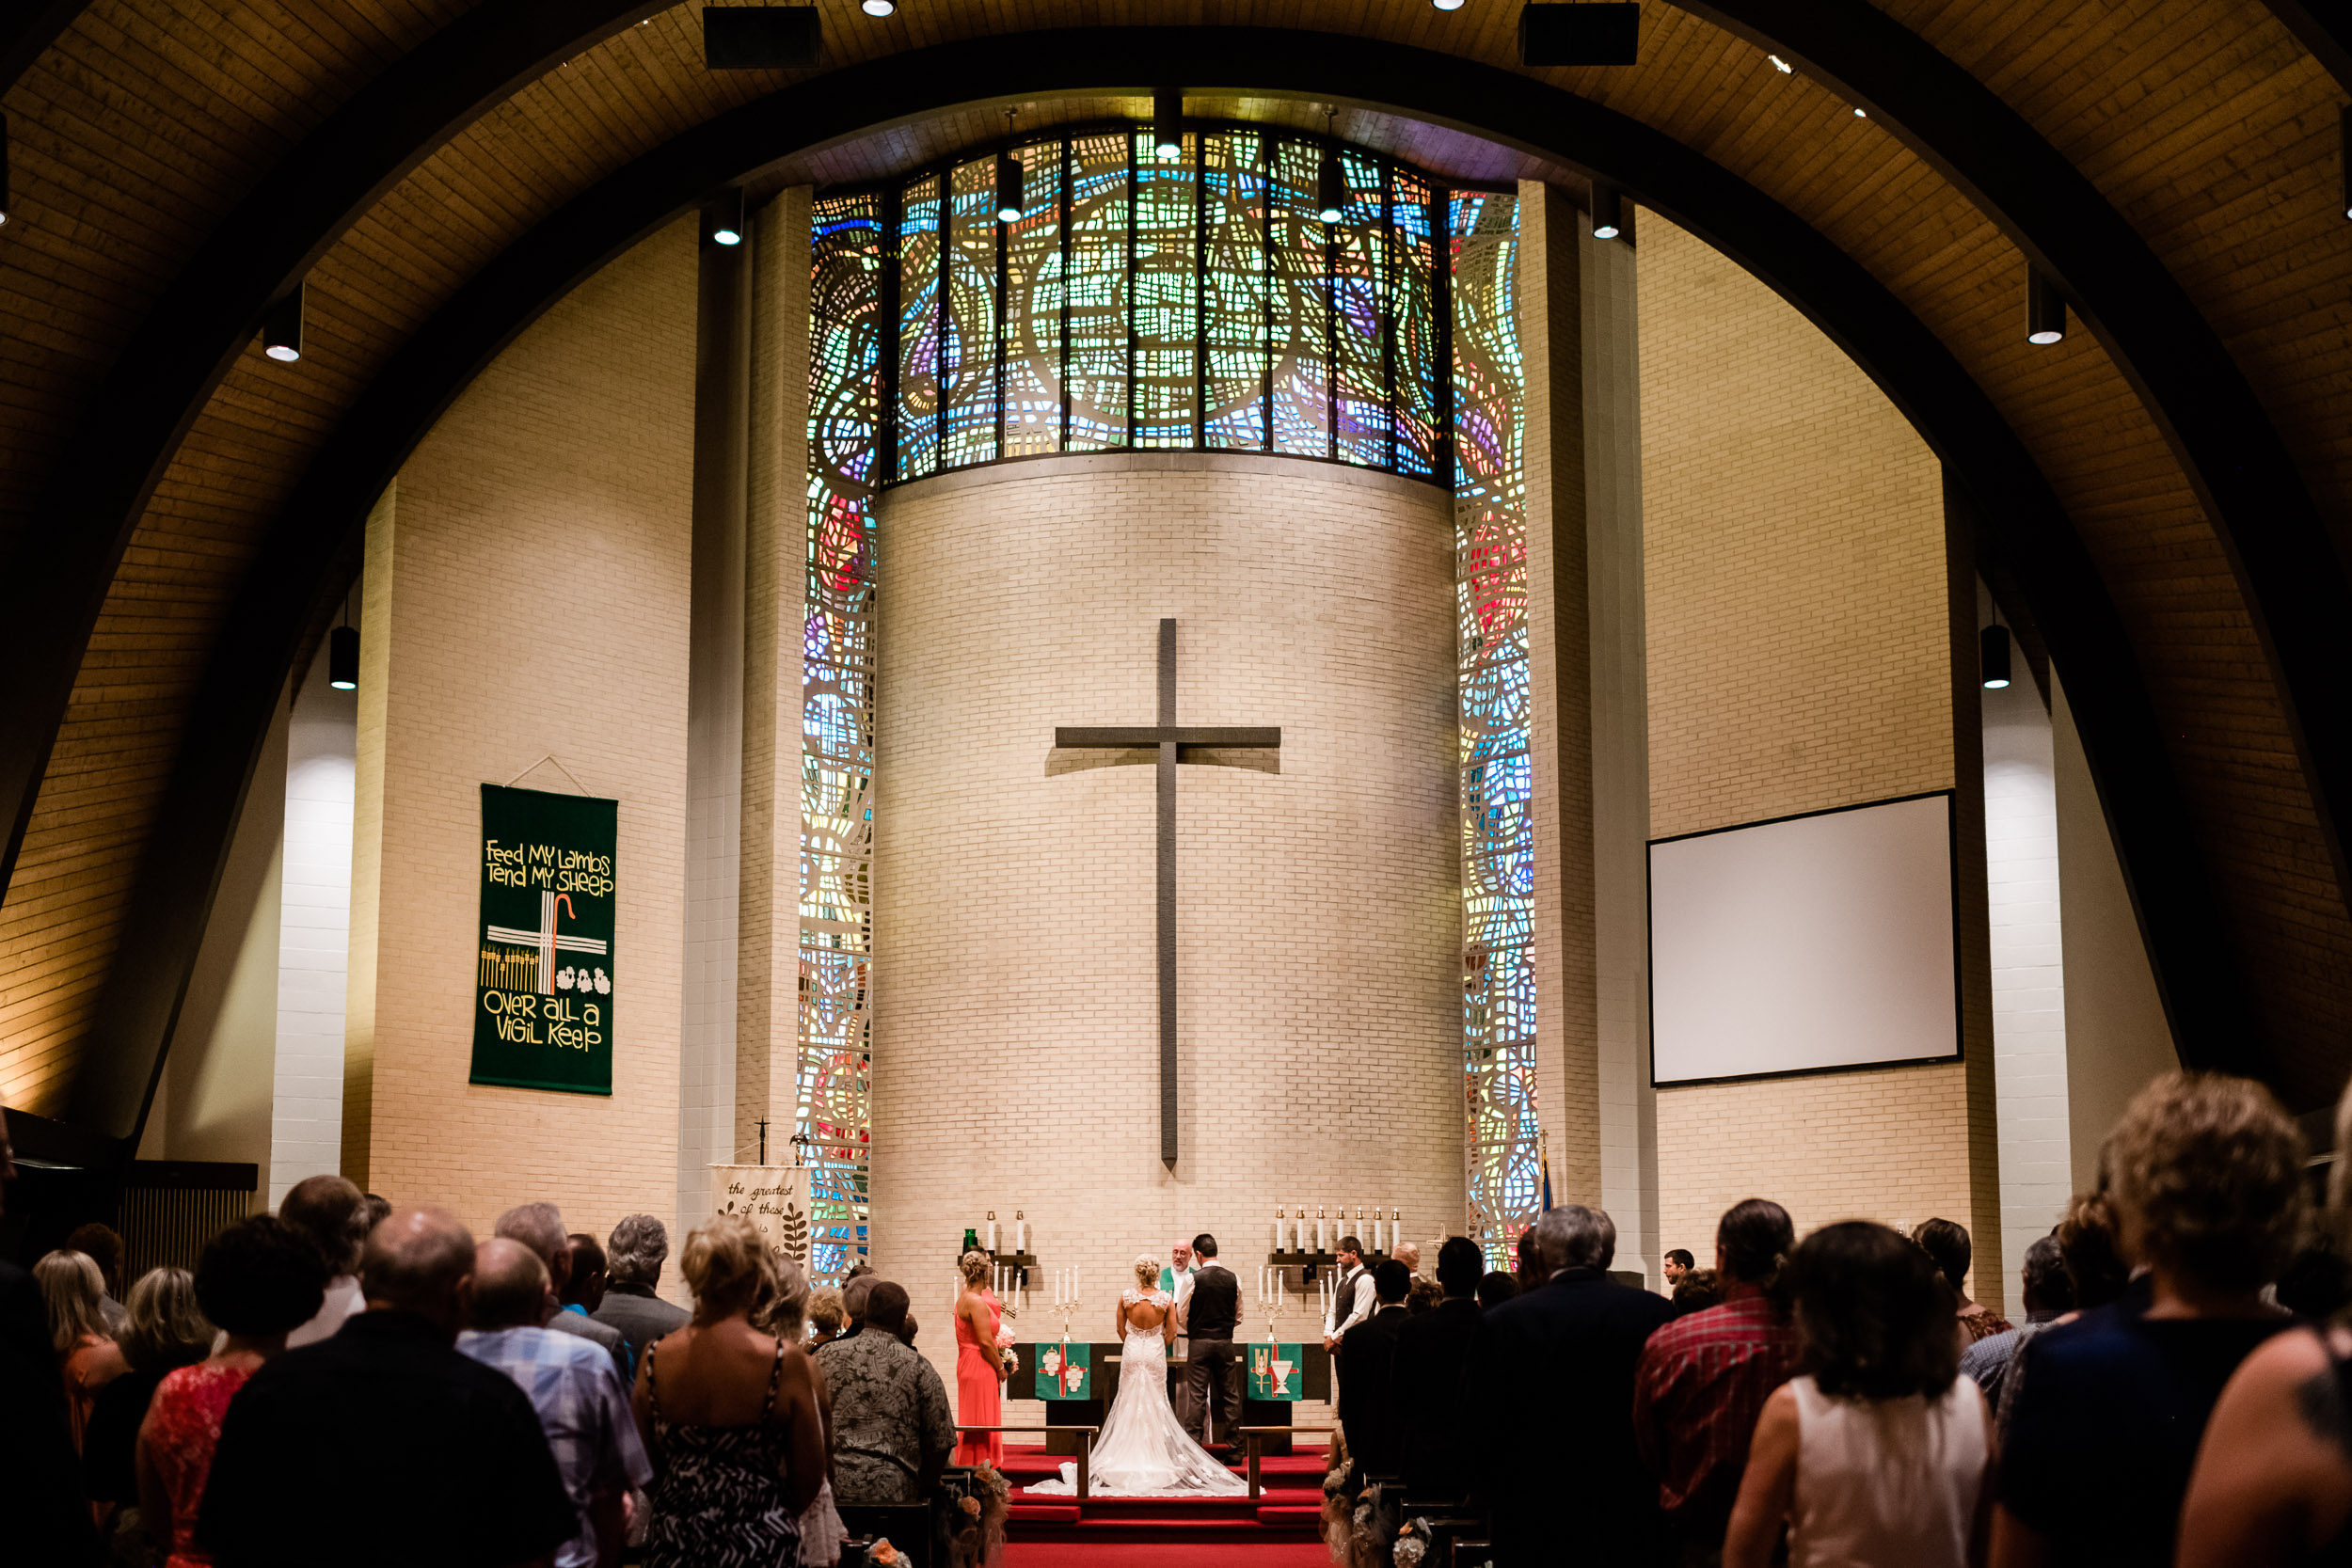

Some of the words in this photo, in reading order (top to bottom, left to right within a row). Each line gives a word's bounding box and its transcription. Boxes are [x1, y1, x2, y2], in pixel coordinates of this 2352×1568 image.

[485, 839, 524, 865] Feed
[558, 848, 611, 877] Lambs
[485, 863, 526, 888] Tend
[583, 1003, 600, 1027] a
[548, 1022, 602, 1053] Keep
[728, 1181, 745, 1195] the
[749, 1184, 793, 1201] greatest
[758, 1201, 785, 1215] these
[758, 1223, 769, 1233] is
